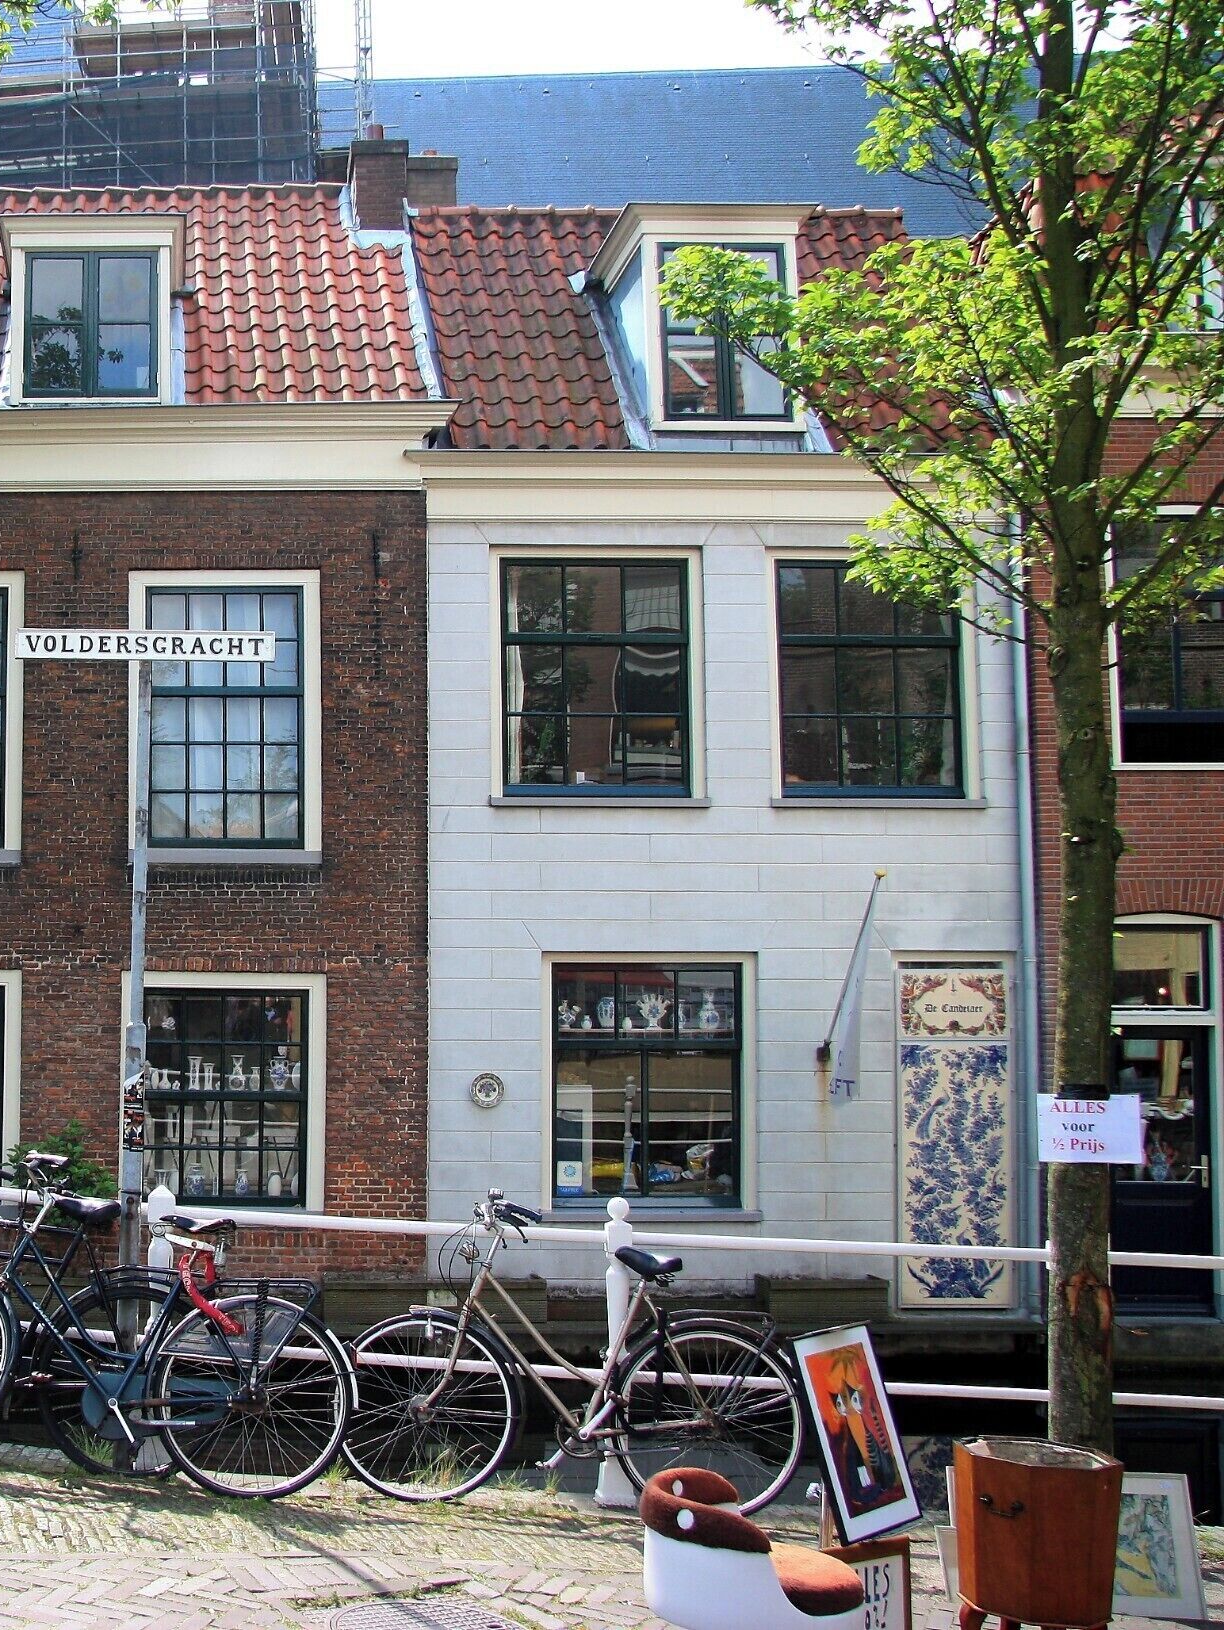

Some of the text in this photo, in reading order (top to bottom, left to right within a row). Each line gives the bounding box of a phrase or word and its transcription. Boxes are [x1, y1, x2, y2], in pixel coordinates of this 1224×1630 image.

[25, 634, 265, 657] VOLDERSGRACHT
[924, 1003, 937, 1013] De
[1050, 1101, 1106, 1114] ALLES
[1062, 1122, 1095, 1132] voor
[1070, 1138, 1105, 1154] Prijs
[855, 1563, 890, 1604] LES
